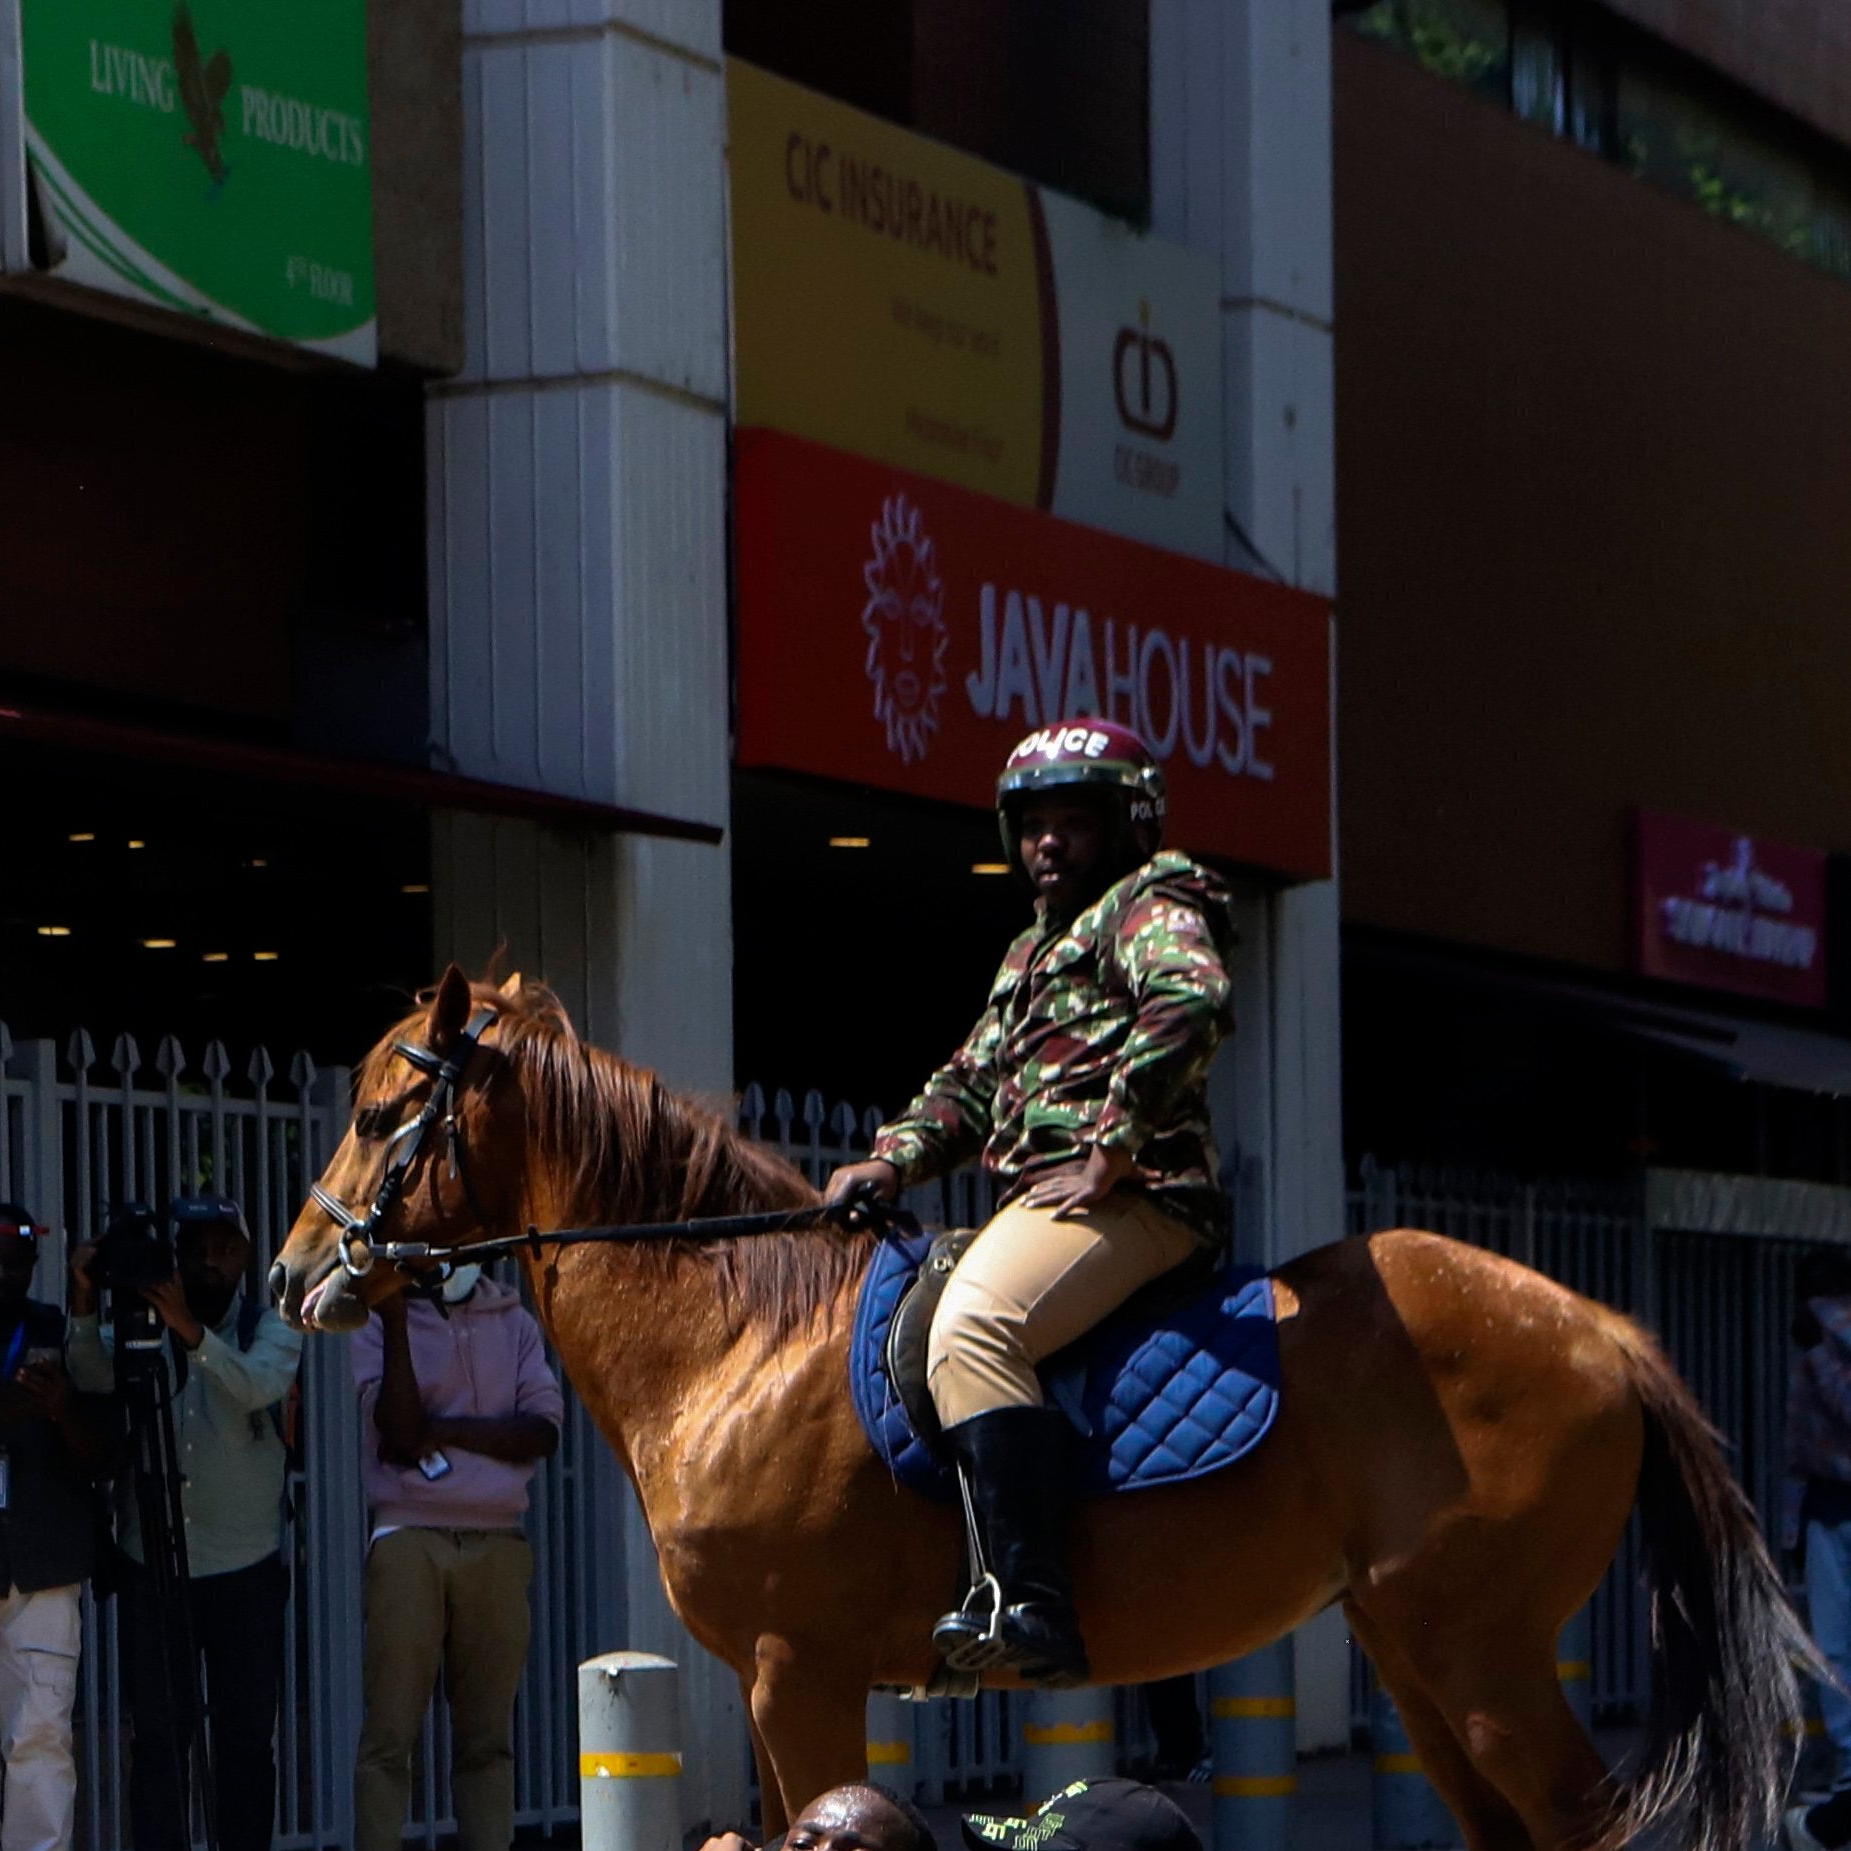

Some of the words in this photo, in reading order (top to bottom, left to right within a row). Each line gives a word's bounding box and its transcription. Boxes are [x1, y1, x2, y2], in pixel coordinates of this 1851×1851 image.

[89, 38, 175, 113] LIVING
[240, 83, 364, 166] PRODUCTS
[786, 130, 833, 213] CIC
[838, 154, 998, 277] INSURANCE
